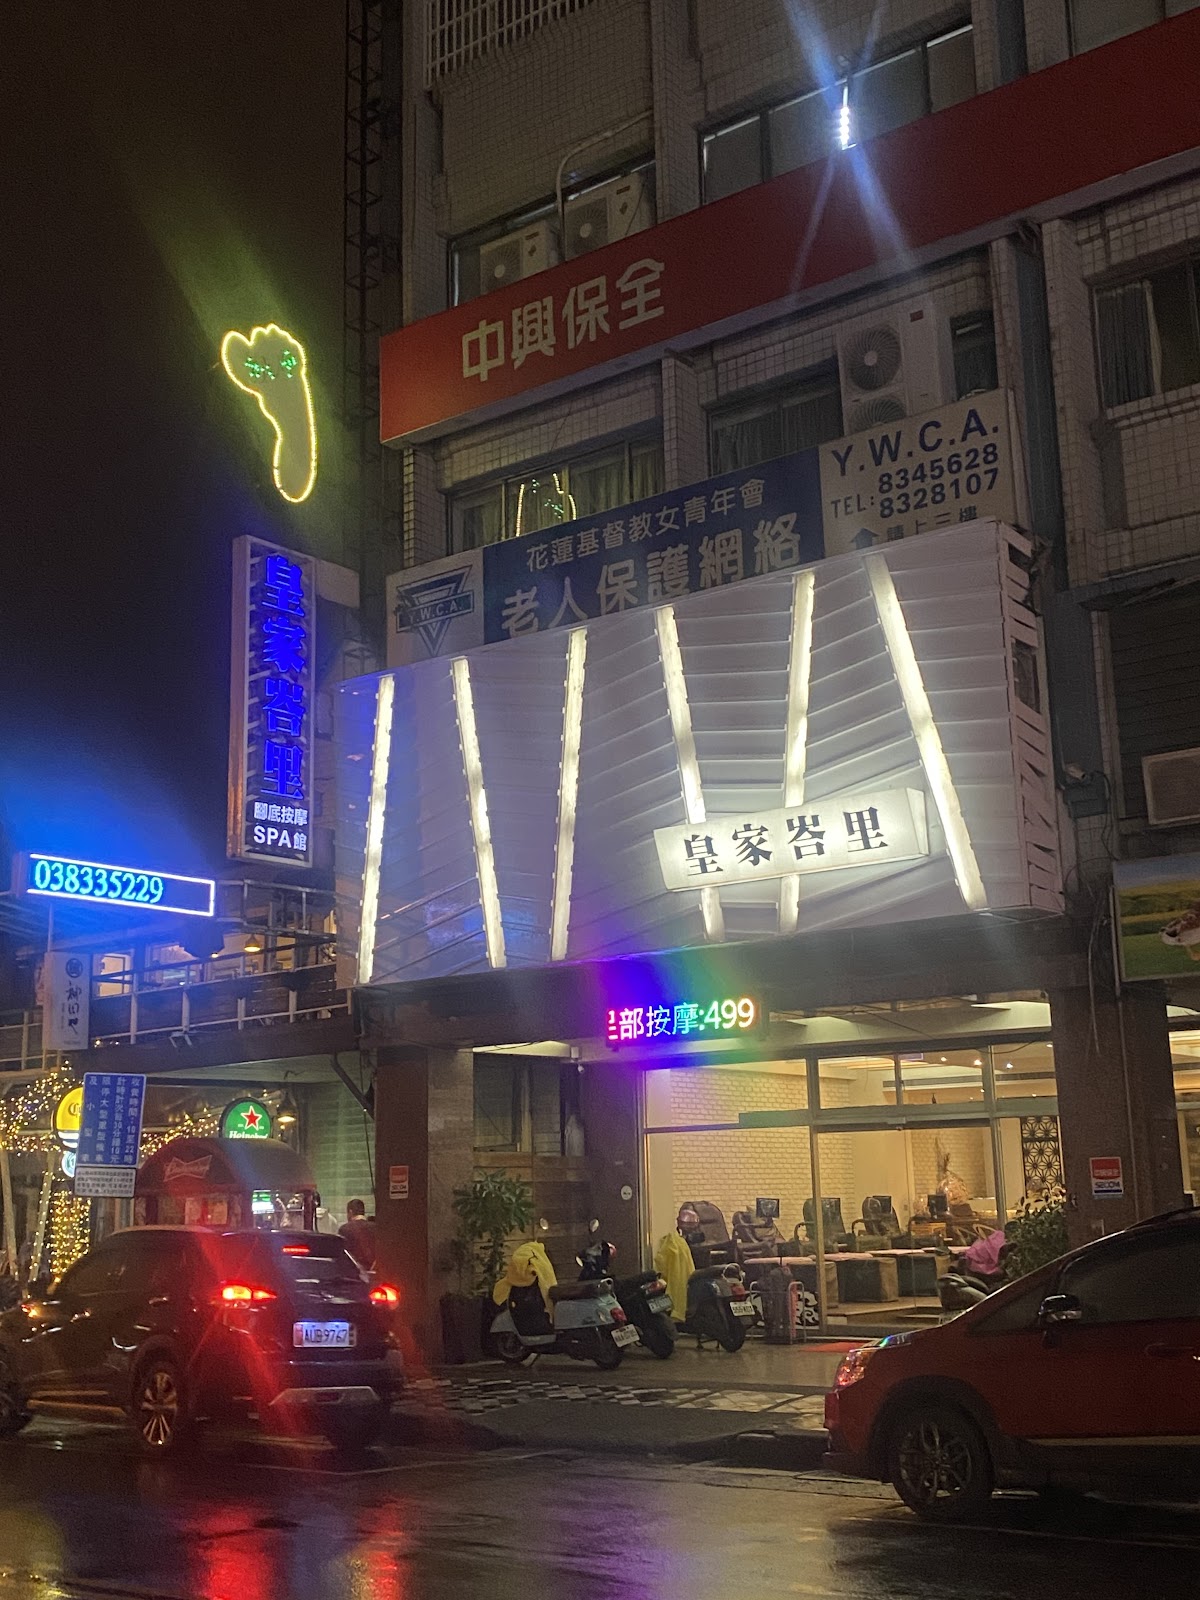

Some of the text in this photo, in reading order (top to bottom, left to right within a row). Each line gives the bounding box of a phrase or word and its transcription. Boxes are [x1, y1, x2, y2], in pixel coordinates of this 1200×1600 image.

[461, 258, 665, 382] 中興保全
[832, 407, 1000, 477] Y.W.C.A.
[878, 442, 1000, 492] 8345628
[526, 478, 767, 573] 花蓮基督教女青年會
[831, 468, 1000, 519] TEL: 8328107
[500, 513, 802, 636] 老人保護網絡
[261, 555, 304, 798] 皇家峇里
[253, 801, 308, 826] 腳底按摩
[253, 825, 308, 851] SPA館
[683, 805, 889, 877] 皇家峇里
[34, 860, 164, 904] 038335229
